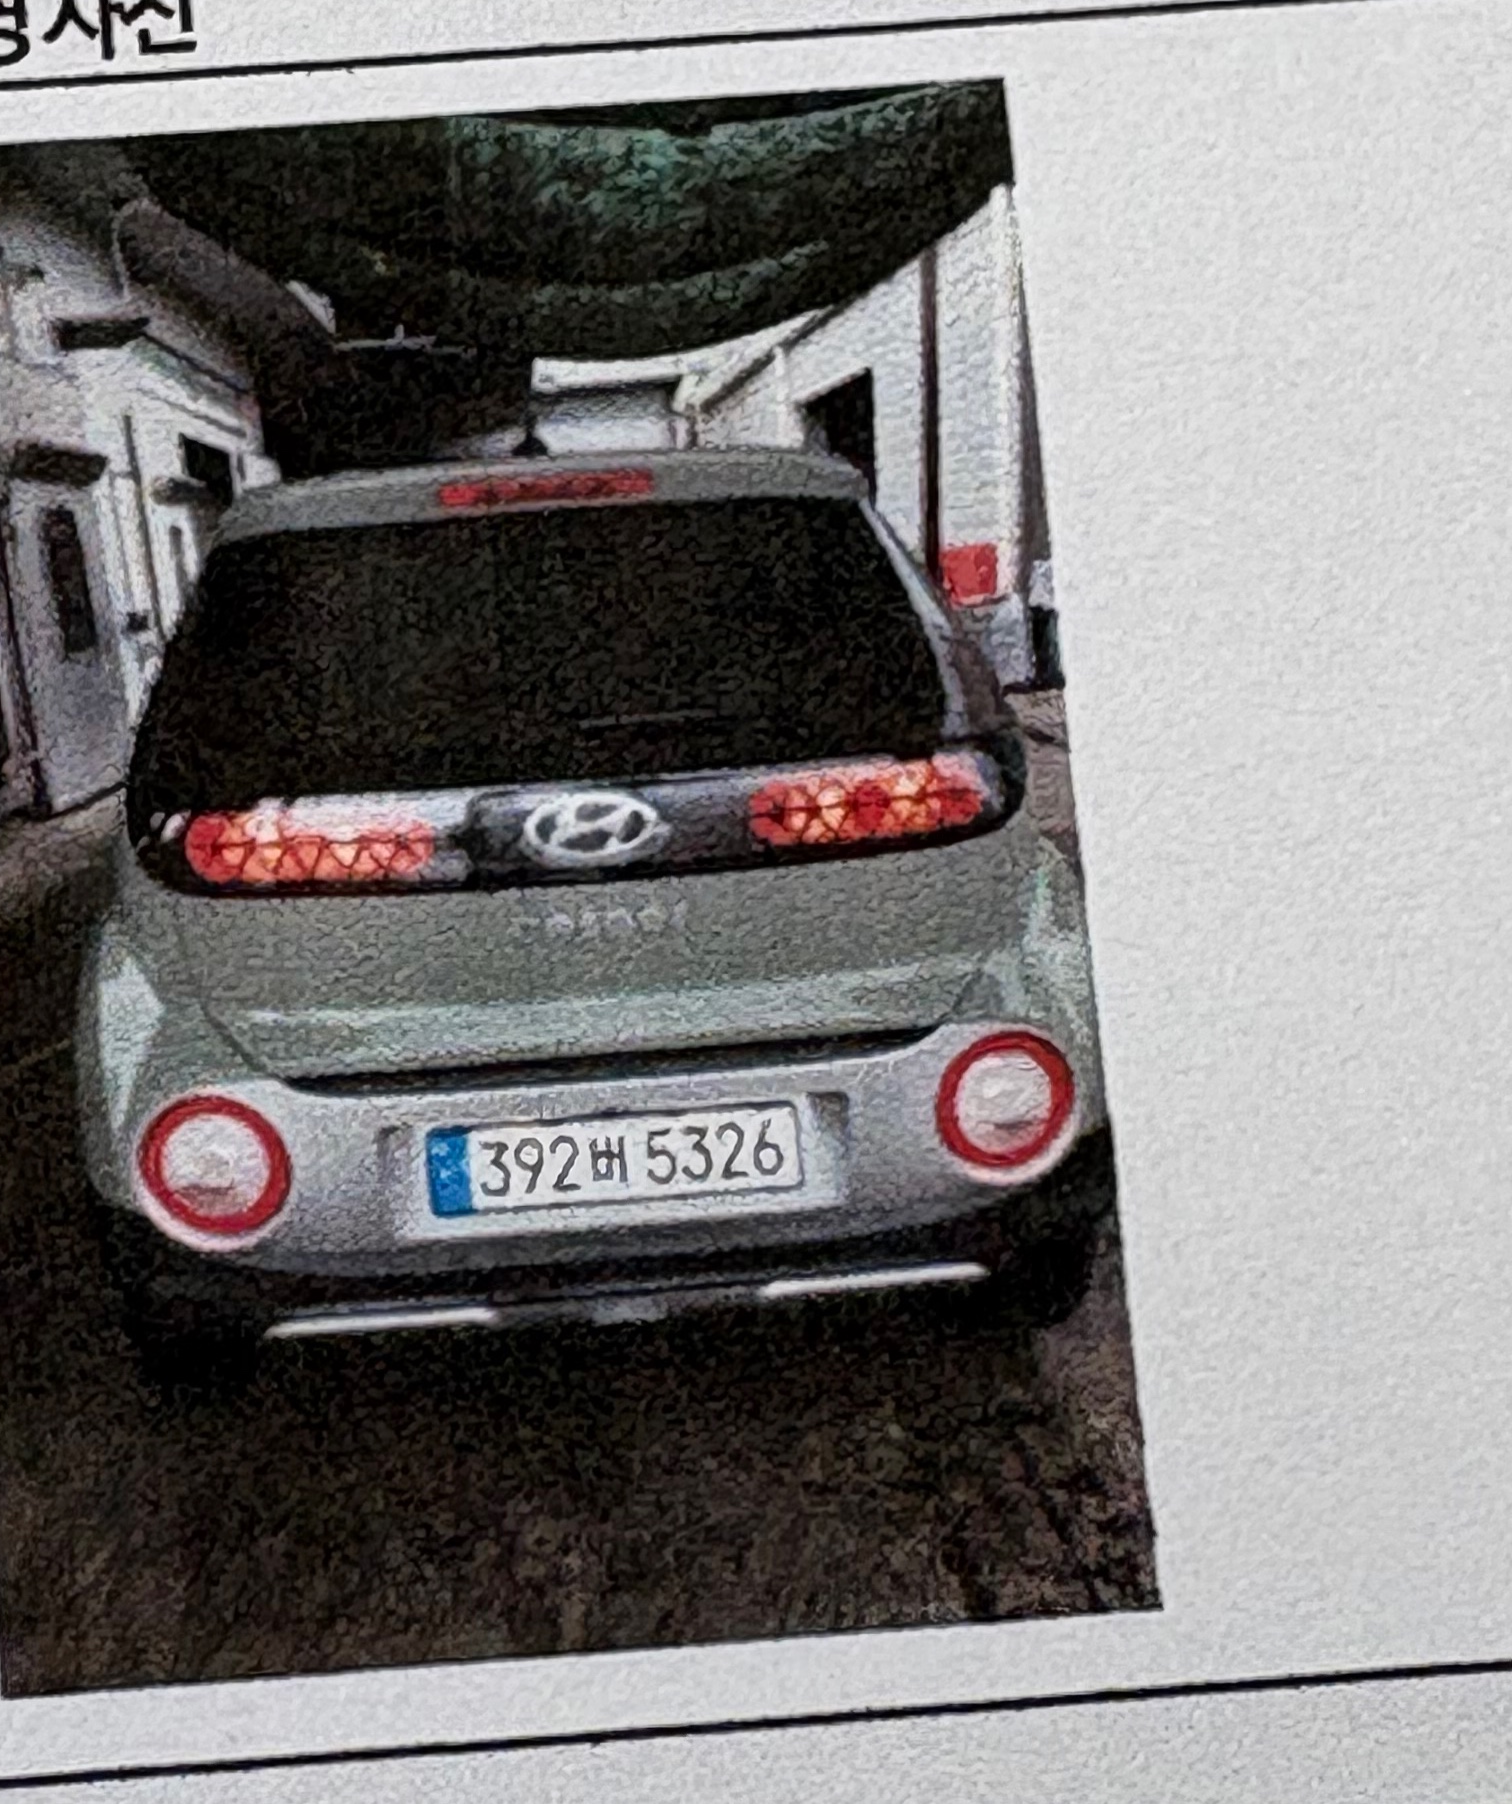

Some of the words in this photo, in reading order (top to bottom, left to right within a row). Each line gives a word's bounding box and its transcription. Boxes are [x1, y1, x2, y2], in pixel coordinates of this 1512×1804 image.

[42, 0, 198, 61] 사진
[478, 1135, 628, 1198] 392버
[646, 1118, 785, 1185] 5326
